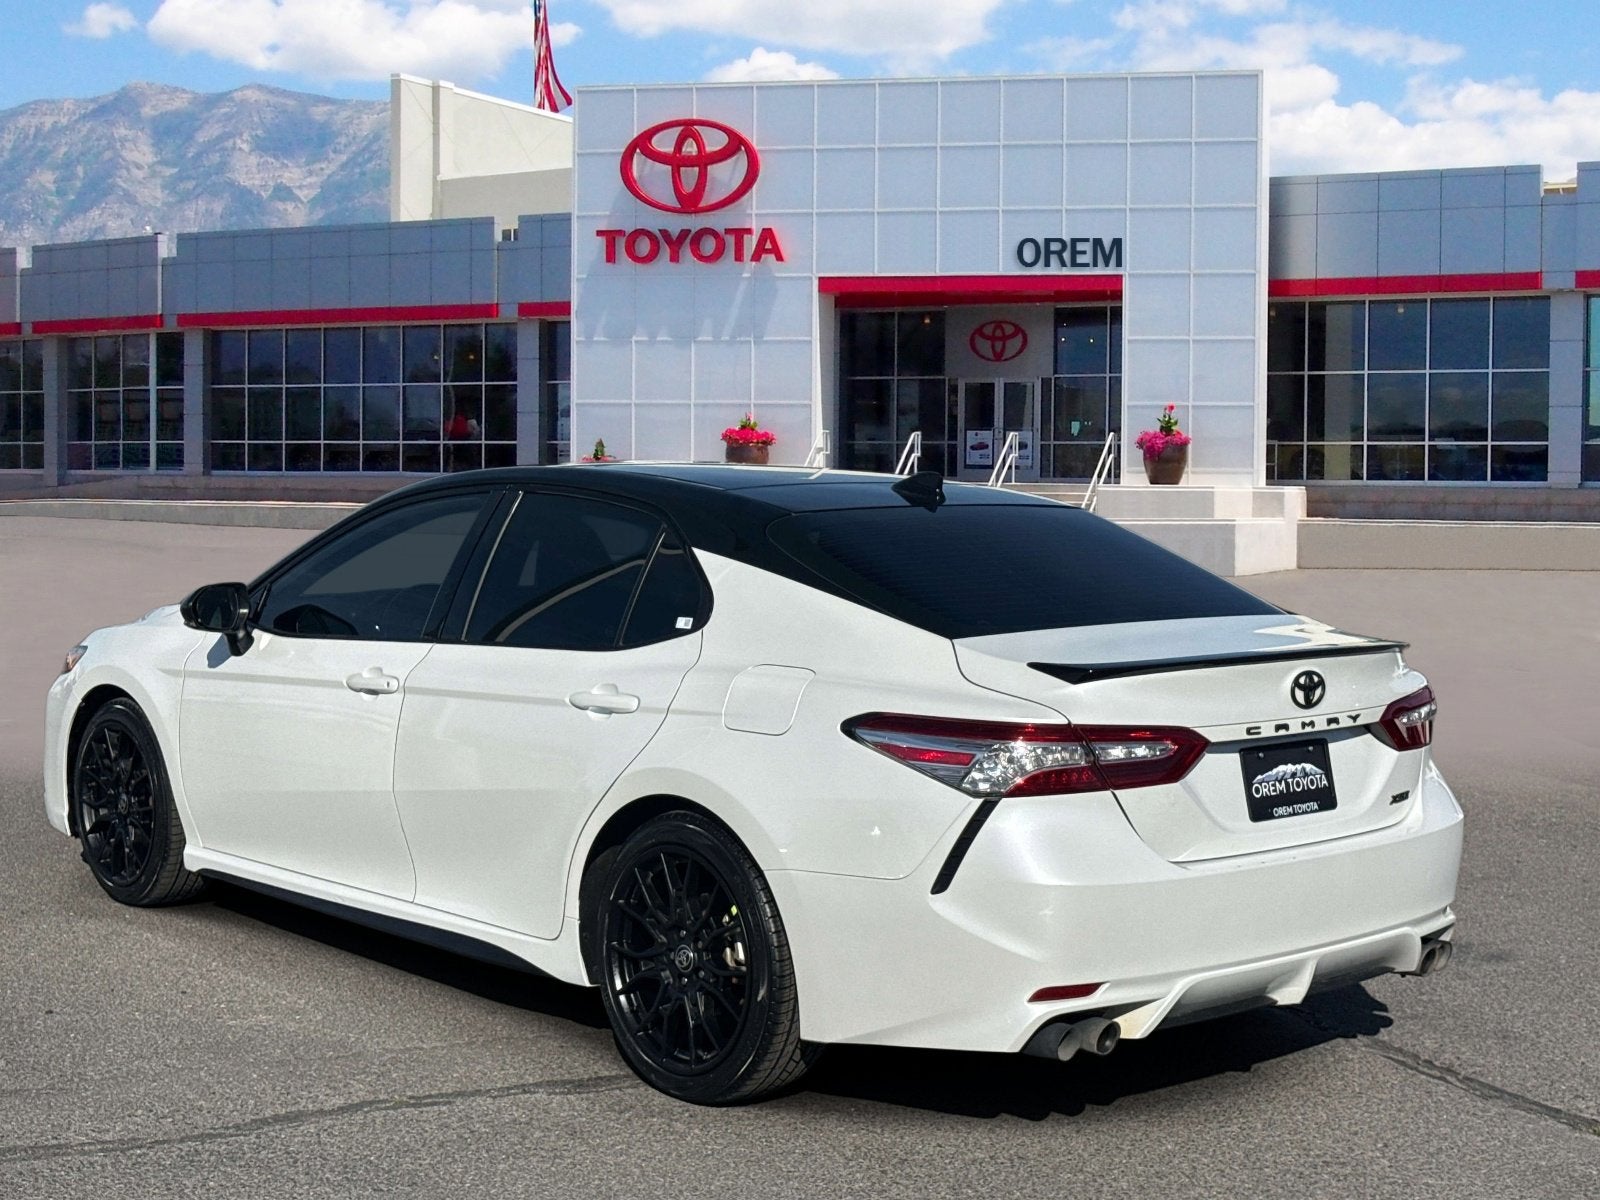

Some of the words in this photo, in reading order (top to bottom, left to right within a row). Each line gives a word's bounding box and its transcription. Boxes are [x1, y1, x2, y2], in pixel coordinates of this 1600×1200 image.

[596, 227, 784, 263] TOYOTA
[1016, 237, 1123, 268] OREM
[1246, 713, 1361, 736] CAMRY
[1252, 780, 1287, 798] OREM
[1289, 774, 1329, 793] TOYOTA
[1273, 806, 1293, 817] OREM
[1294, 802, 1319, 815] TOYOTA
